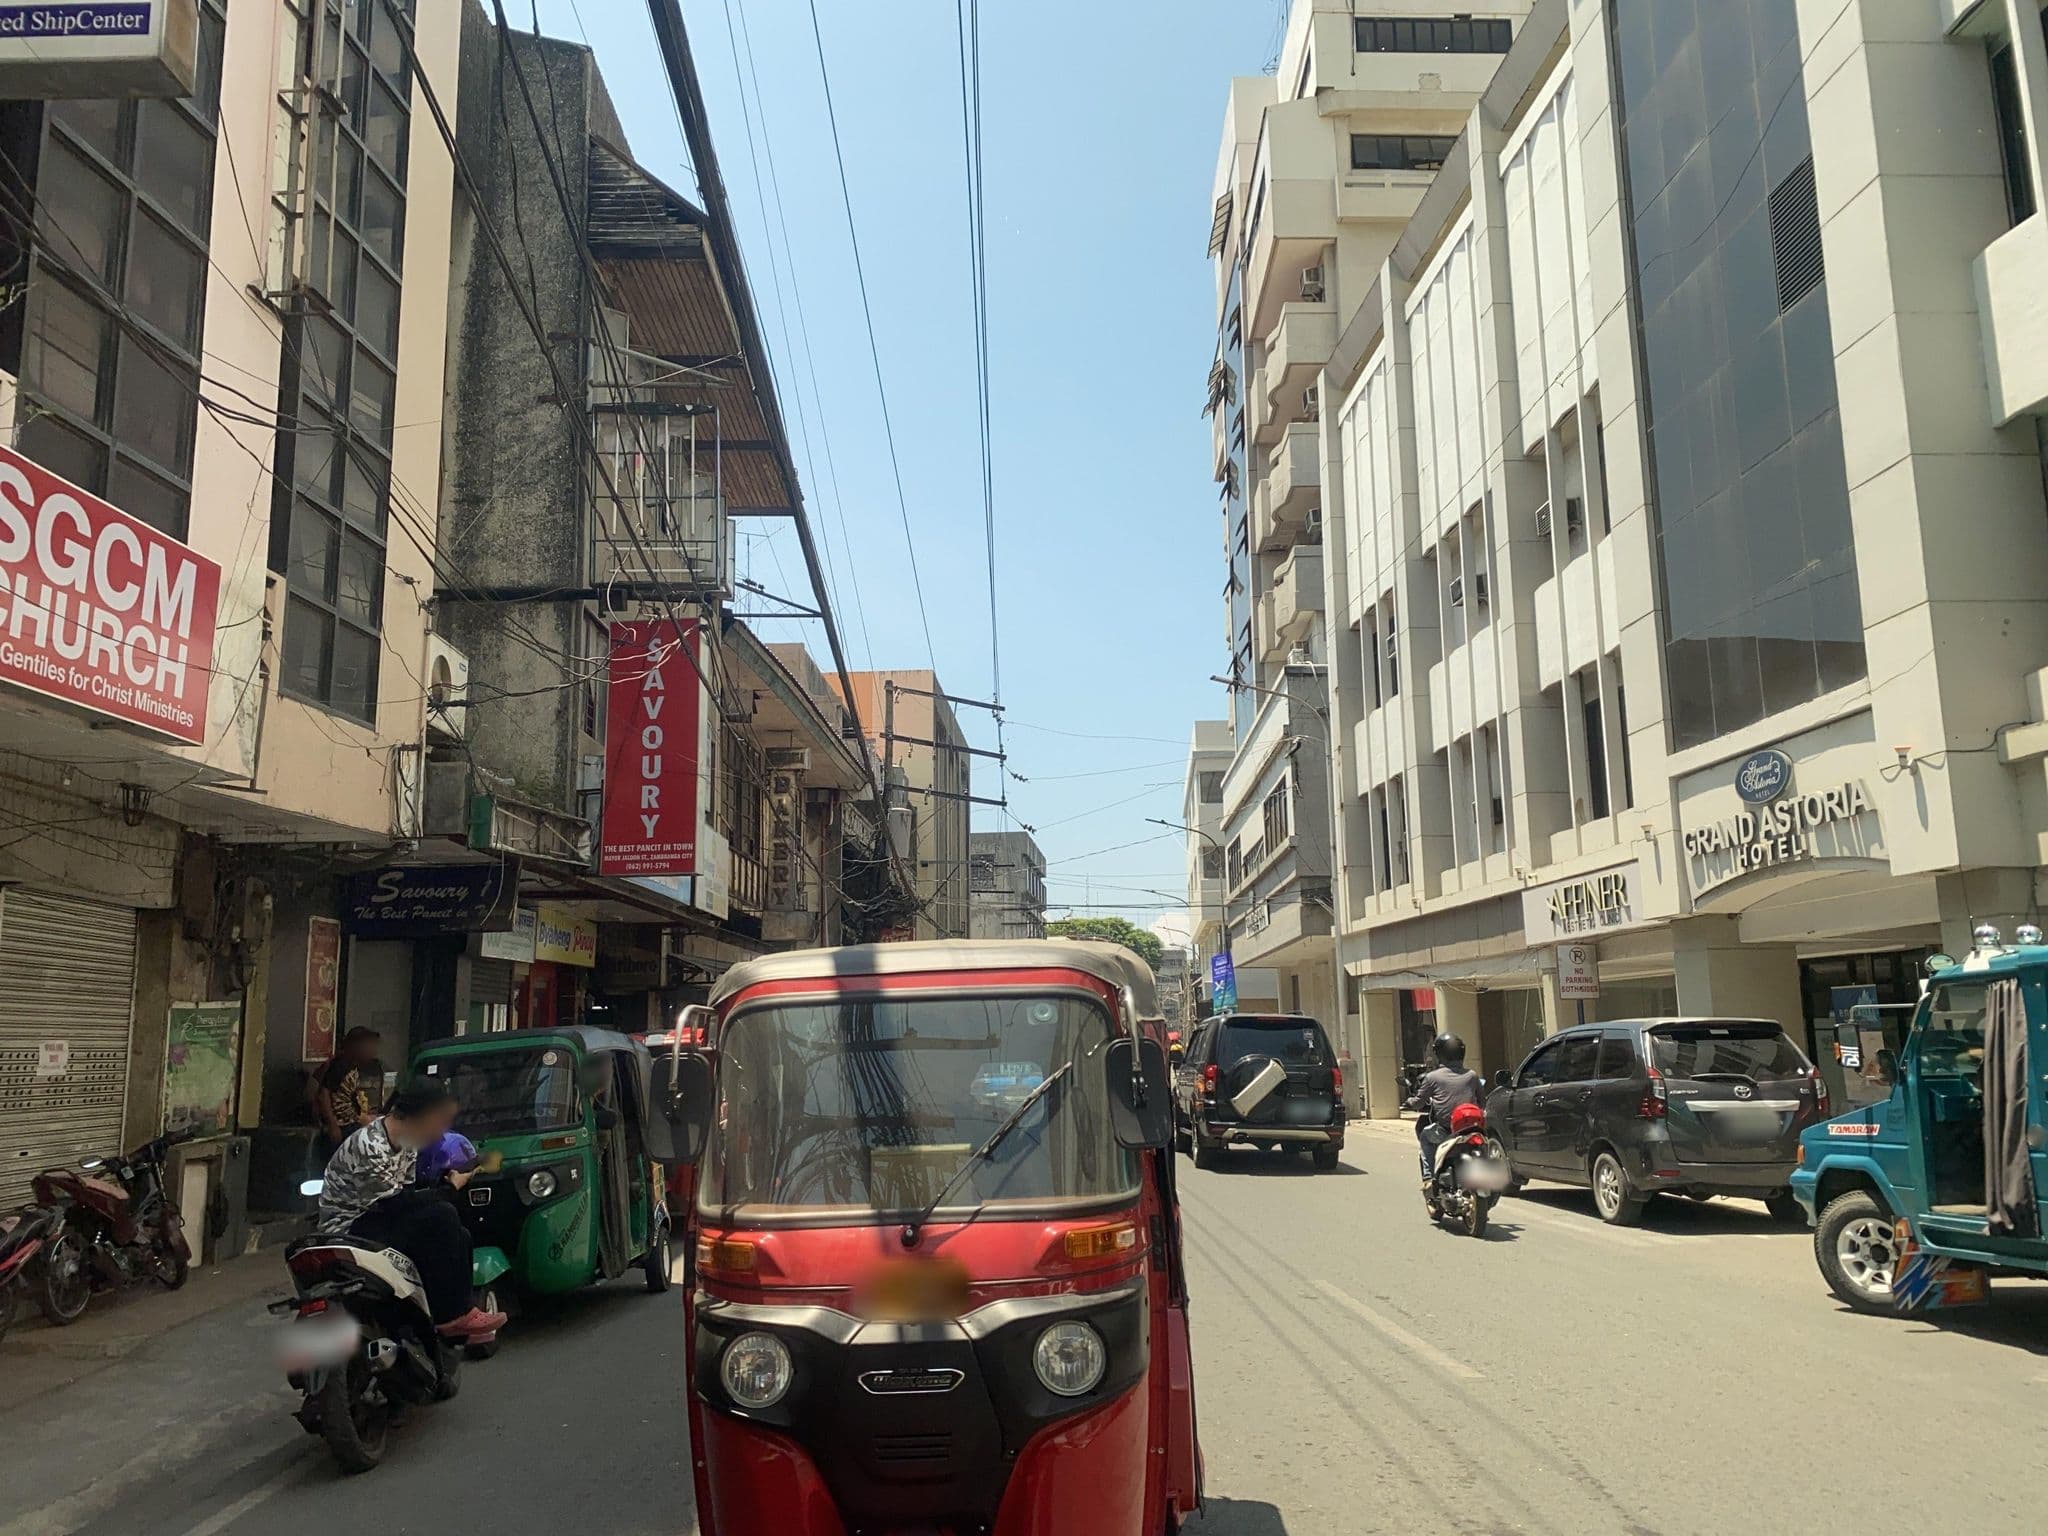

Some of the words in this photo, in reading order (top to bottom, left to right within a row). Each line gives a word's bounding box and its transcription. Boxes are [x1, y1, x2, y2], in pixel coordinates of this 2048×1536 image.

[31, 10, 144, 34] ShipCenter
[0, 461, 197, 640] SGCM
[0, 565, 188, 699] HURCH
[0, 641, 66, 682] Gentiles
[68, 666, 90, 691] for
[92, 677, 132, 706] Christ
[135, 690, 194, 728] Ministries
[640, 638, 664, 839] SAVOURY
[1747, 755, 1773, 778] Grand
[1684, 811, 1756, 858] GRAND
[1760, 778, 1873, 839] ASTORIA
[637, 844, 661, 852] PANCIT
[673, 843, 693, 851] TOWN
[773, 776, 791, 906] BAKERY
[1737, 833, 1803, 867] HOTEL
[371, 871, 469, 902] Savoury
[1546, 873, 1629, 919] AFFINER
[354, 906, 376, 920] The
[381, 906, 408, 920] Best
[411, 905, 453, 919] Pancit
[456, 910, 469, 919] in
[1565, 976, 1593, 984] PARKING
[1829, 1124, 1879, 1135] TAMARAW
